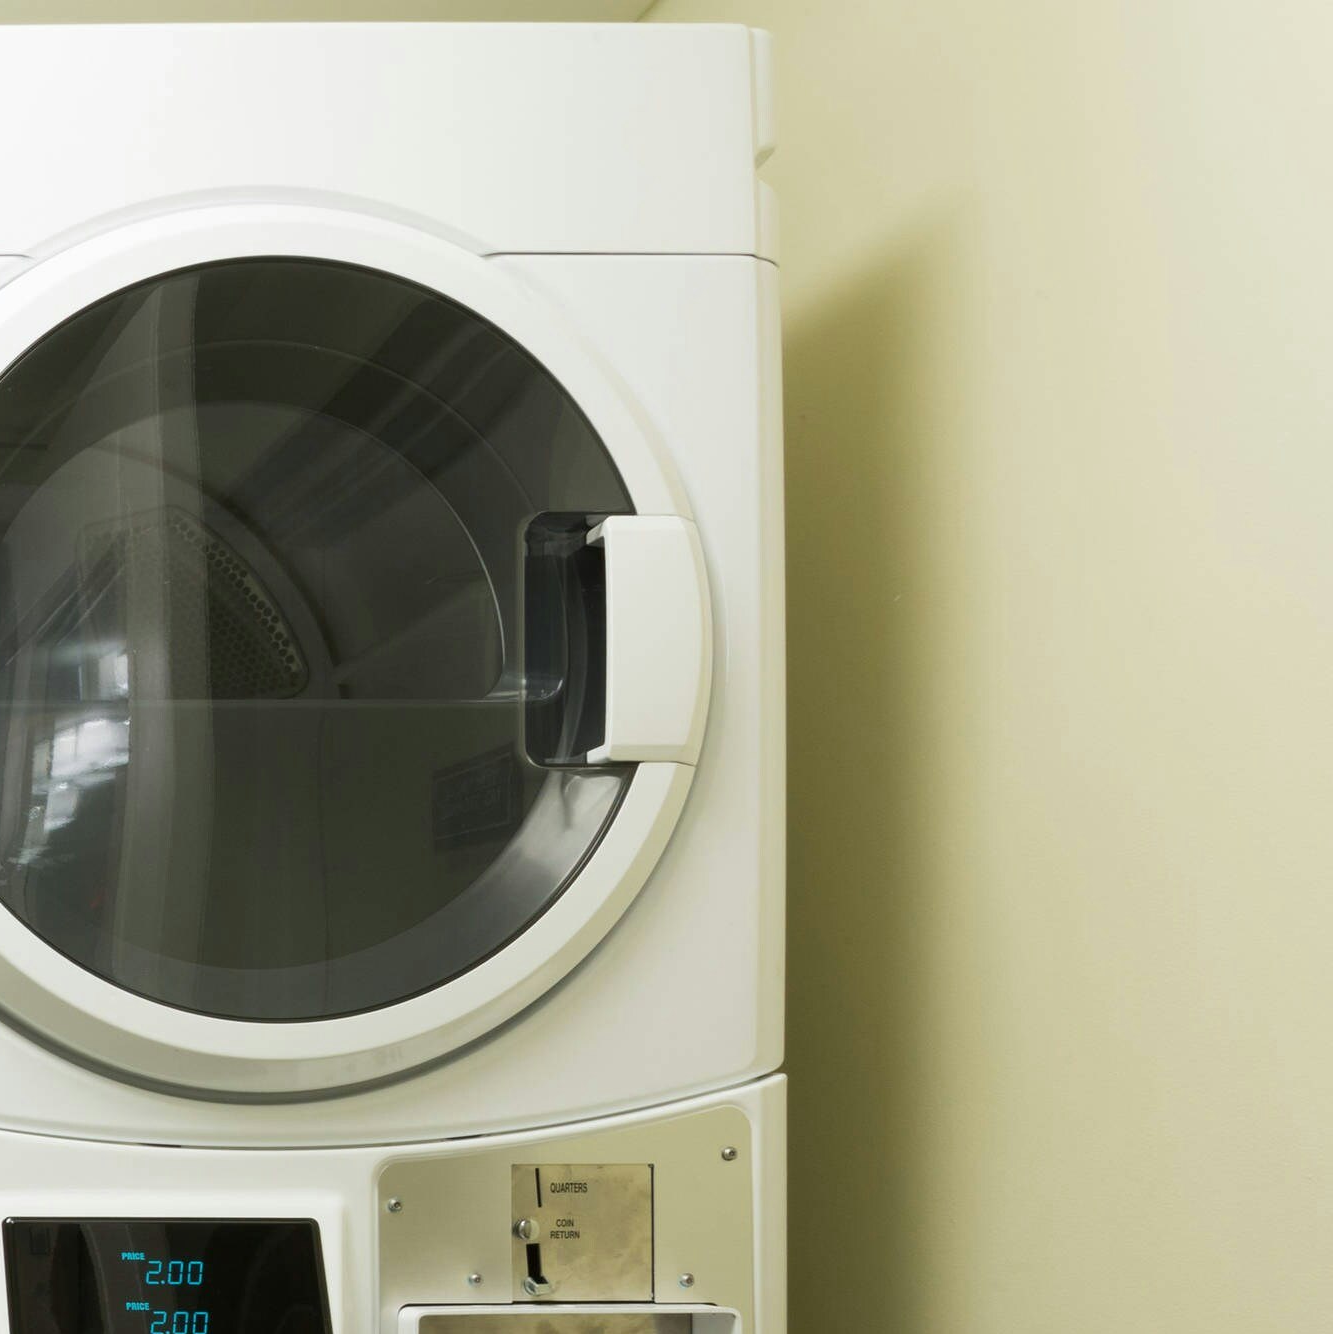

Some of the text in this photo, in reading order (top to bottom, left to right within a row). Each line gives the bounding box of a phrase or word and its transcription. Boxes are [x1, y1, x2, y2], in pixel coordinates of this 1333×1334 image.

[550, 1183, 588, 1193] QUARTERS
[556, 1219, 574, 1227] COIN
[550, 1231, 580, 1239] RETURN
[121, 1252, 145, 1260] PRICE
[145, 1260, 204, 1285] 2.00
[126, 1302, 150, 1311] PRICE
